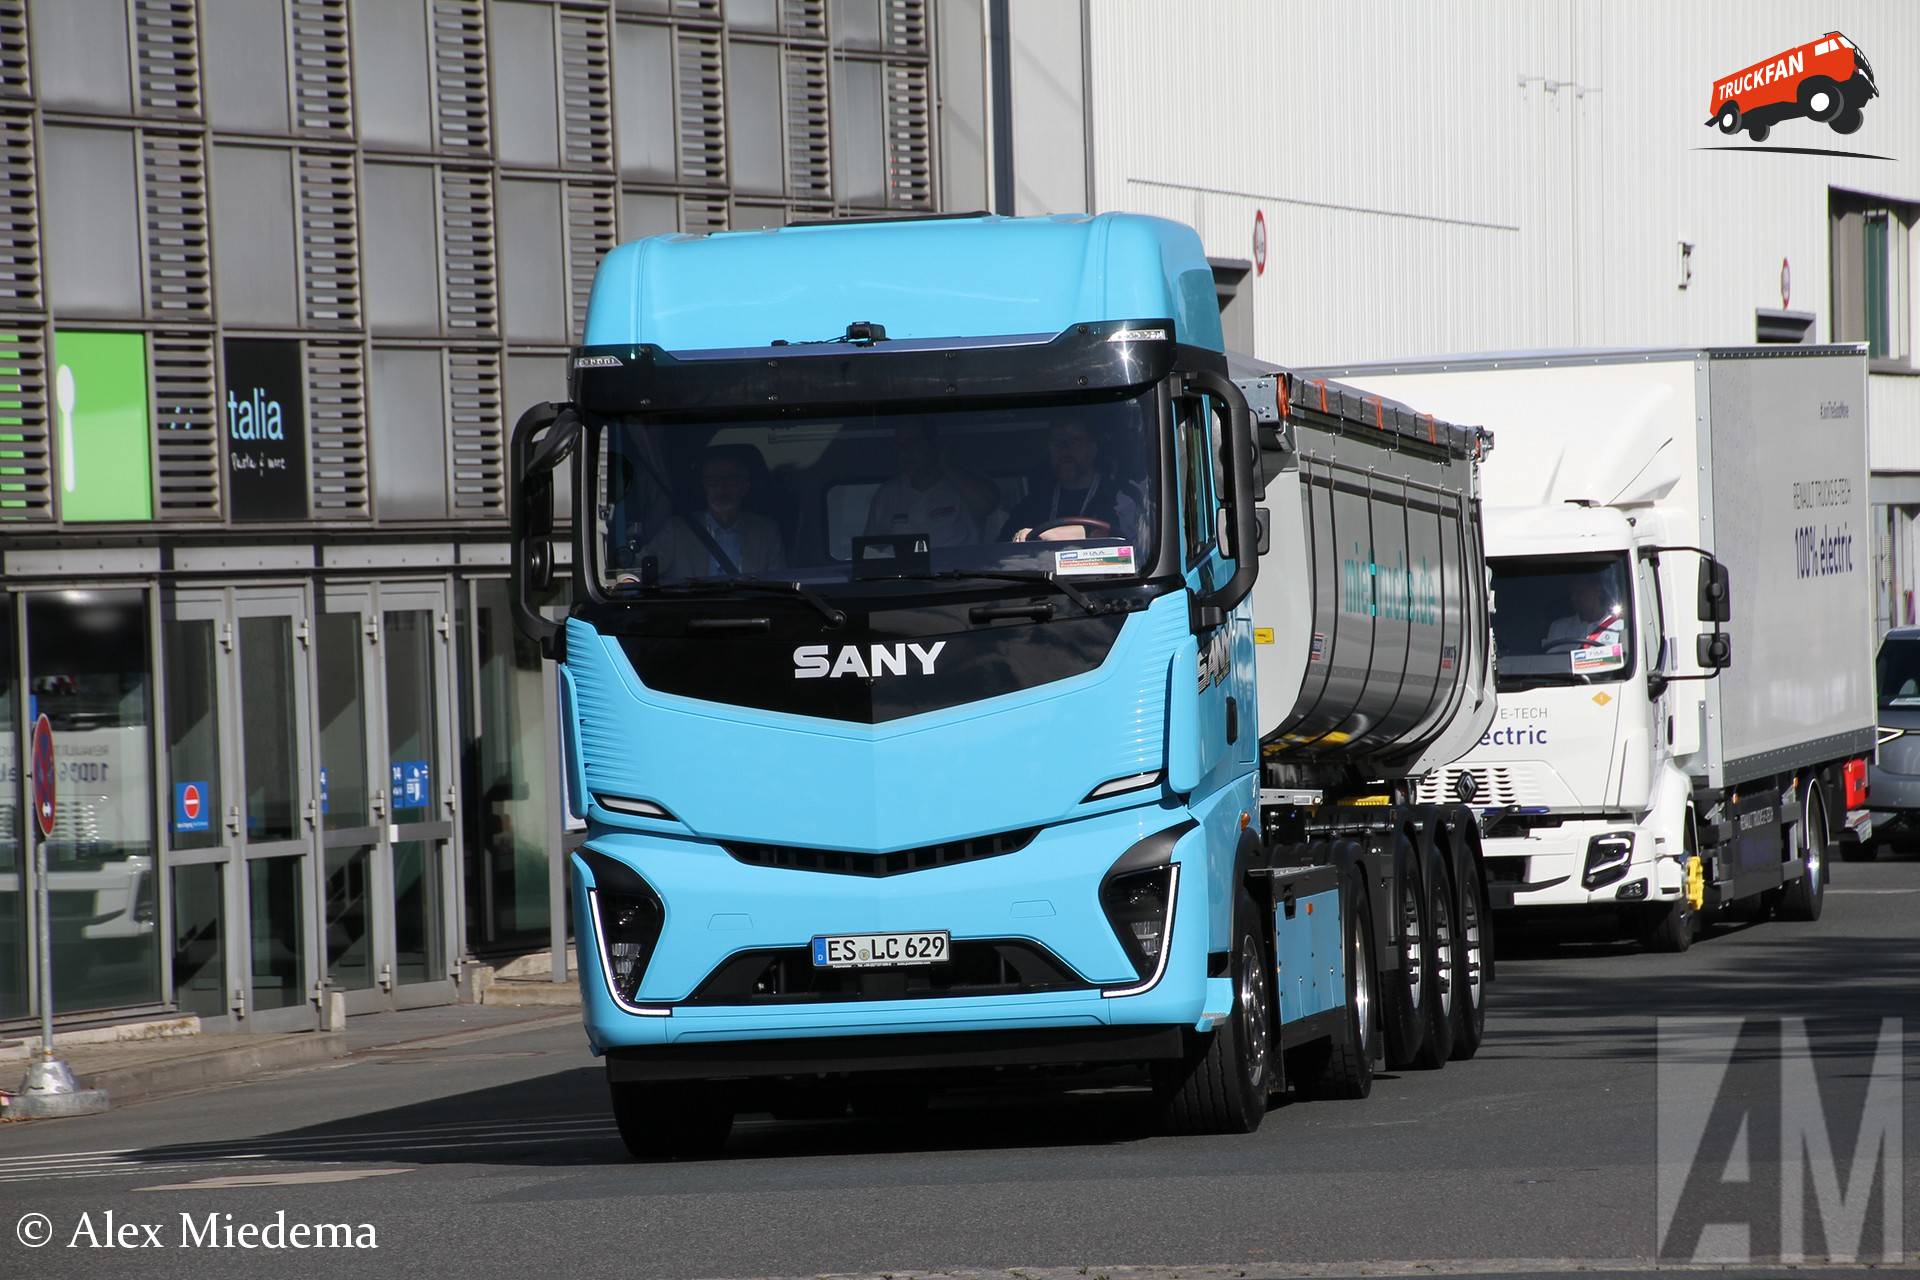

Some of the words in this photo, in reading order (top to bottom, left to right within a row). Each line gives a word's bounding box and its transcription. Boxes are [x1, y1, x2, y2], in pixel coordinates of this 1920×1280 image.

[1795, 525, 1819, 580] 100%
[1820, 521, 1853, 576] electric
[793, 640, 947, 679] SANY
[1500, 707, 1548, 719] E-TECH
[1480, 724, 1548, 746] ectric
[828, 939, 857, 961] ES
[871, 938, 900, 960] LC
[905, 936, 945, 958] 629
